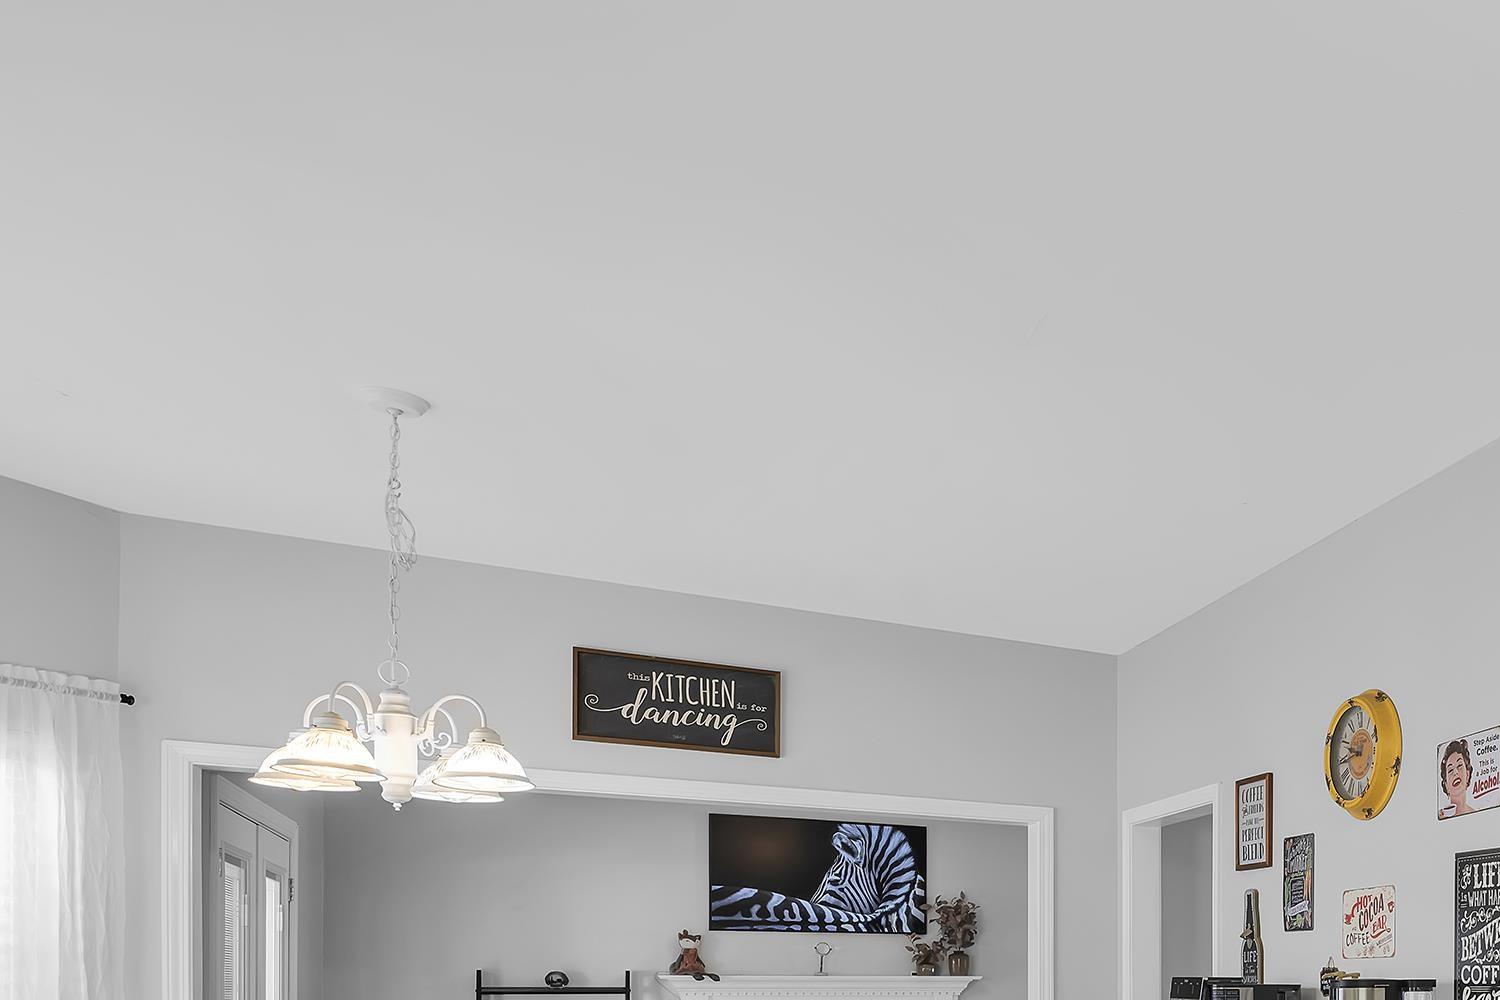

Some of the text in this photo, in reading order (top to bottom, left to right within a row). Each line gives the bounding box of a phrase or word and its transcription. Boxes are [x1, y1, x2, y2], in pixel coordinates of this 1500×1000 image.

[627, 671, 767, 713] this KITCHEN is for
[621, 687, 738, 746] dancing
[1485, 733, 1500, 743] Aside
[1476, 744, 1499, 756] Coffee.
[1479, 759, 1490, 768] This
[1242, 842, 1265, 861] BLEND
[1356, 894, 1373, 912] HOT
[1467, 890, 1487, 907] WHAT
[1358, 893, 1384, 931] COCOA
[1345, 931, 1371, 947] COFFEE
